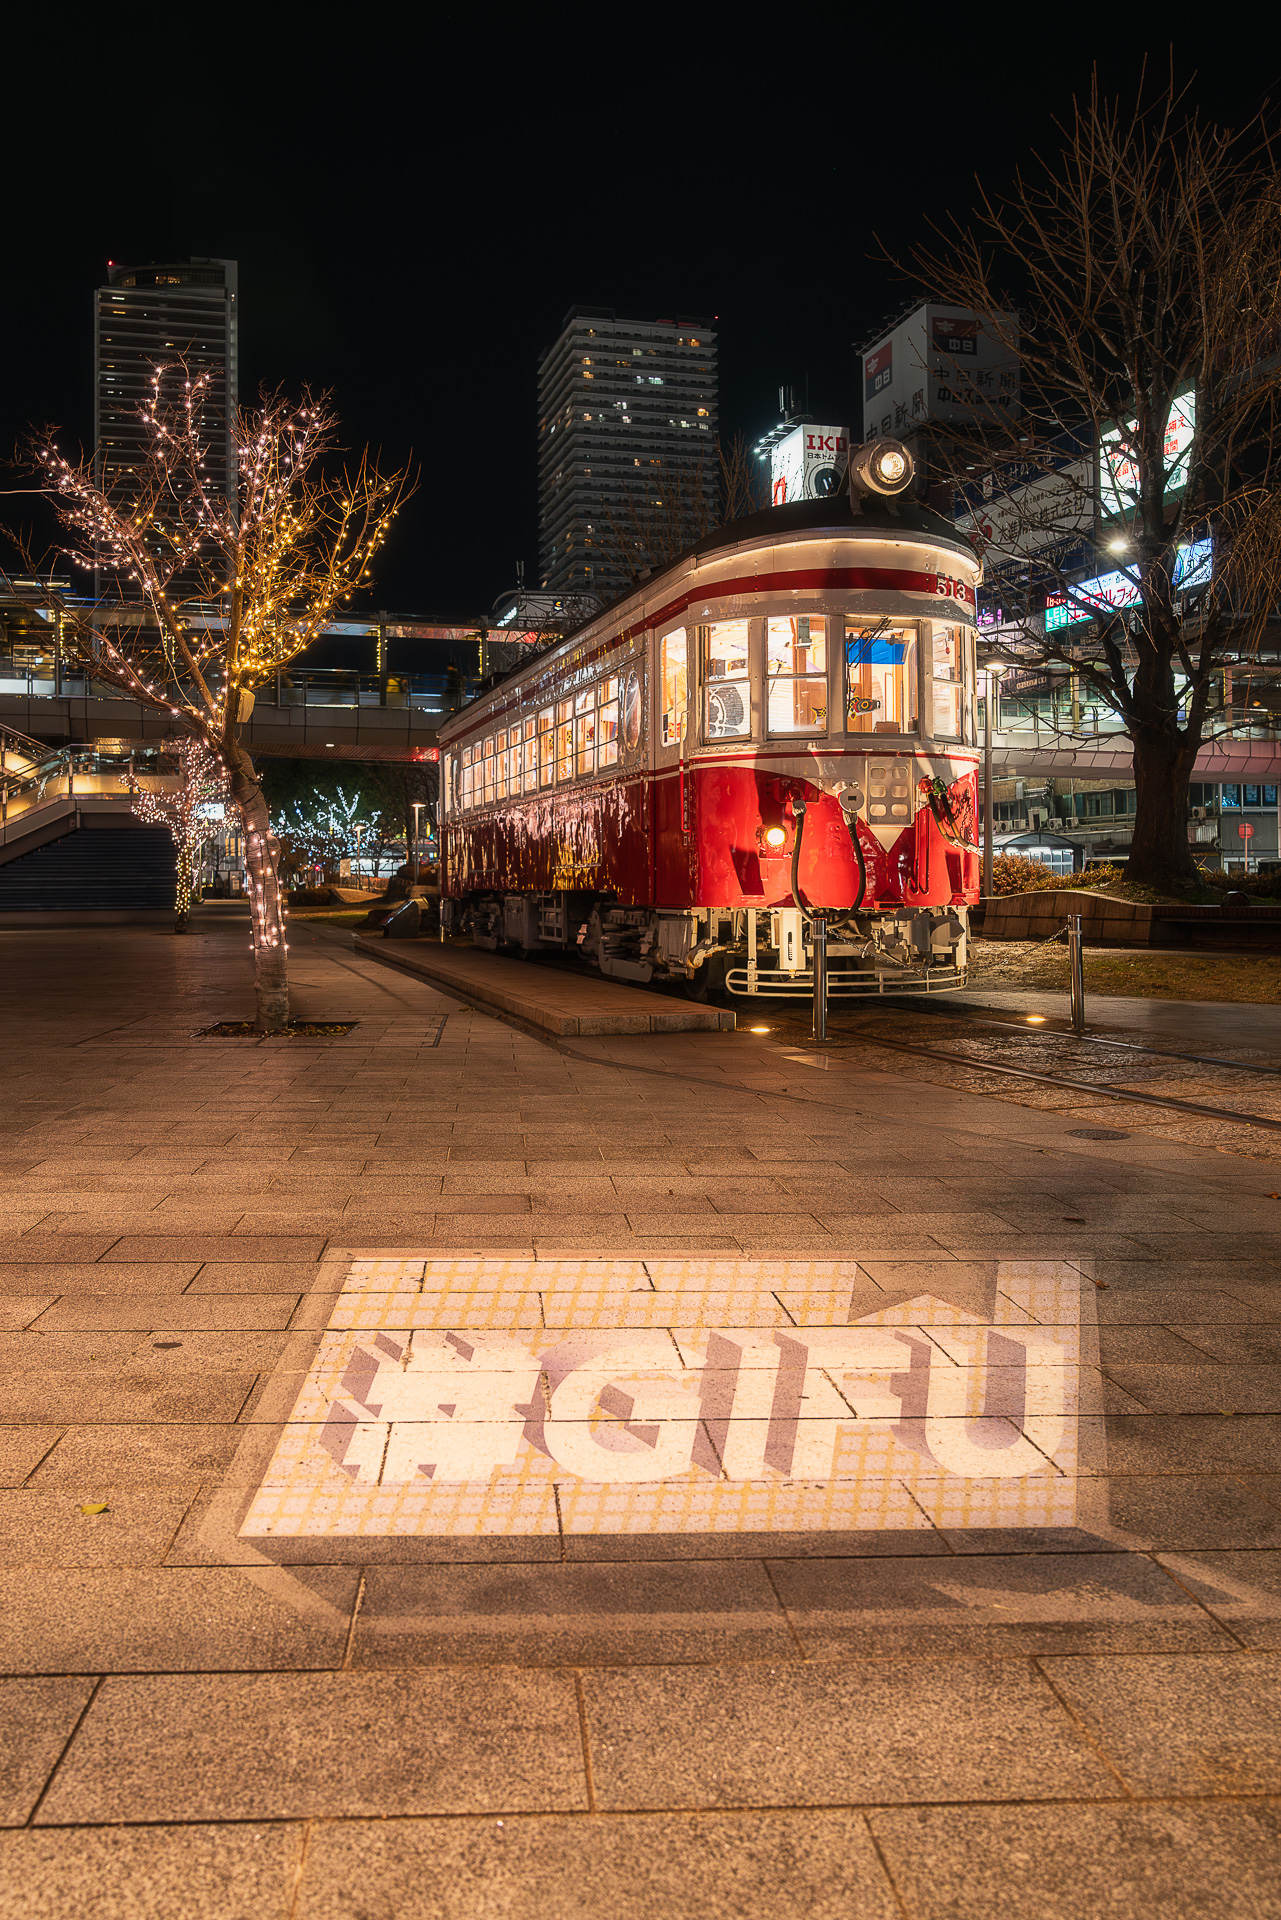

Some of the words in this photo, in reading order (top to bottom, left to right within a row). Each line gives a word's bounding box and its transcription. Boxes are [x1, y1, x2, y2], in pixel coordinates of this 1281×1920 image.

[949, 338, 973, 352] 中日
[874, 367, 891, 391] 中日
[933, 366, 1015, 388] 中日新聞
[866, 388, 923, 443] 中日新聞
[806, 434, 847, 452] IKO
[807, 452, 848, 461] 日本トムソン
[936, 577, 966, 601] 513
[1046, 606, 1067, 620] LED
